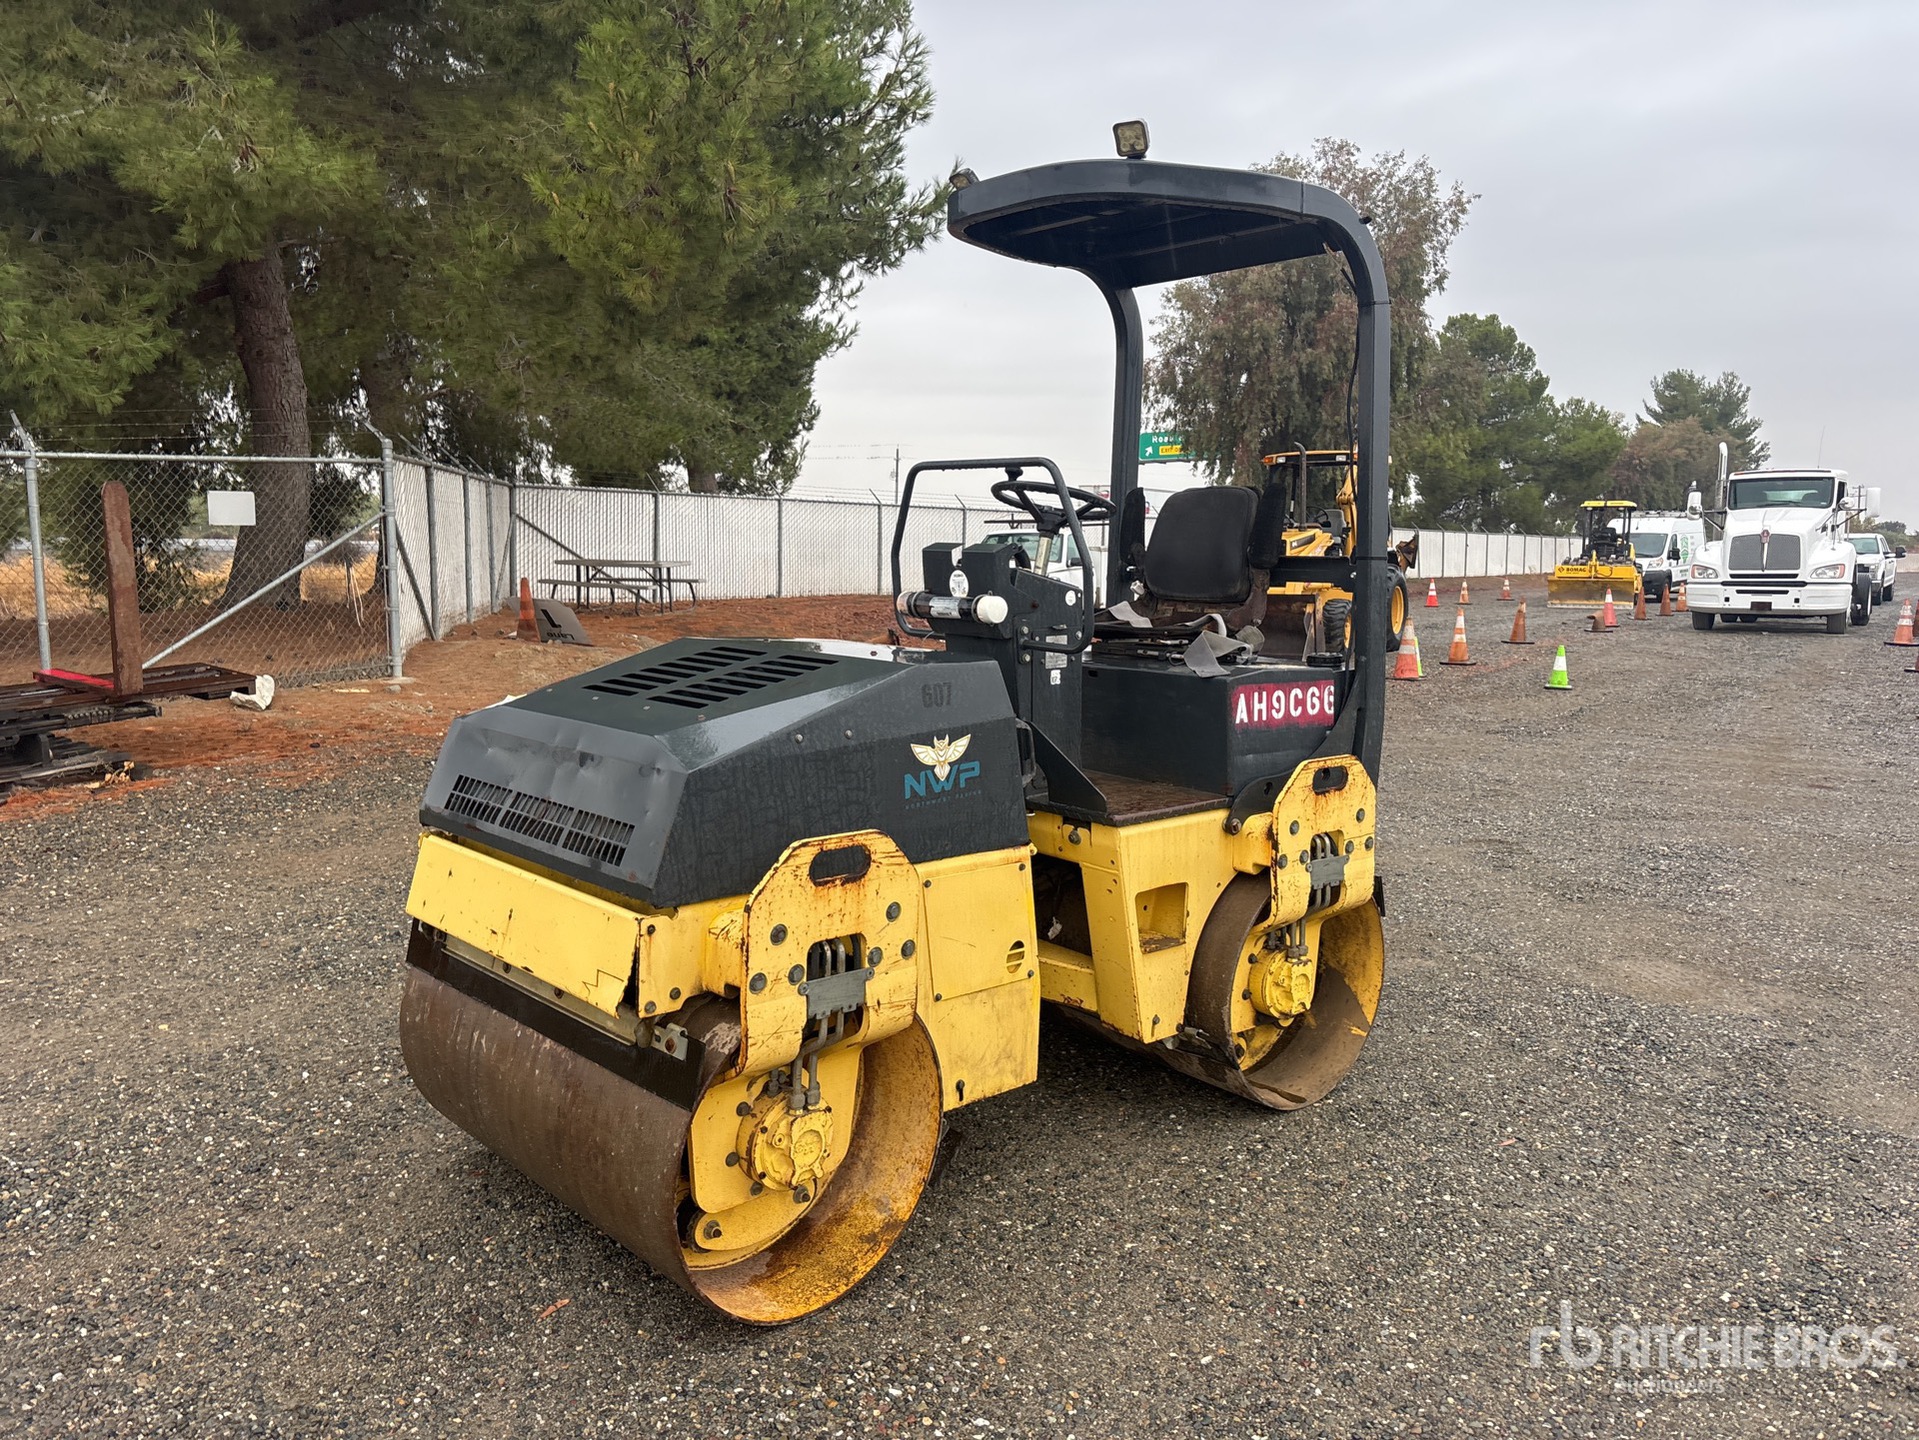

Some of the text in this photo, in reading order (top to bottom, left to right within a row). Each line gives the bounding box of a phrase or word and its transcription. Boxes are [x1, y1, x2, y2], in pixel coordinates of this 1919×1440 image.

[547, 631, 575, 640] Lane
[921, 682, 952, 708] 607
[904, 761, 981, 799] NWP
